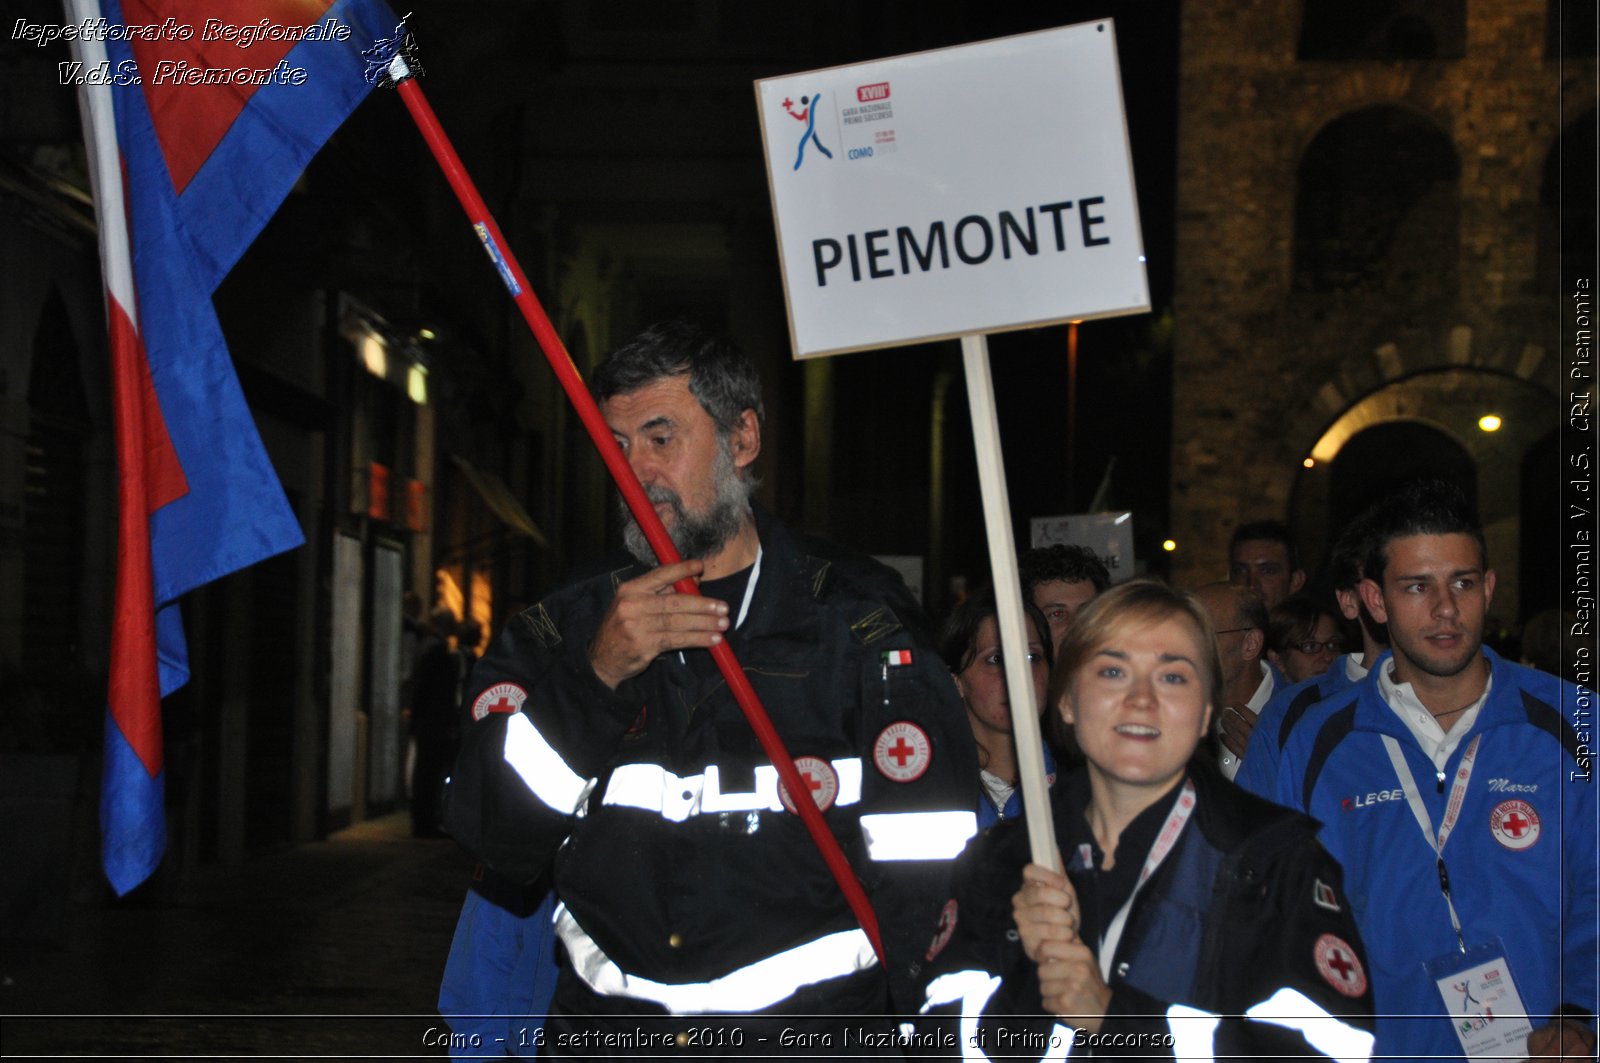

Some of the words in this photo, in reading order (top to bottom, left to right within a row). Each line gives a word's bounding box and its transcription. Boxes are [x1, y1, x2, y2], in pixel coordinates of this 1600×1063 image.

[844, 115, 863, 125] PRIMO
[848, 146, 874, 160] COMO
[812, 196, 1111, 288] PIEMONTE
[1488, 777, 1539, 794] Marco
[1355, 788, 1408, 808] LEGE
